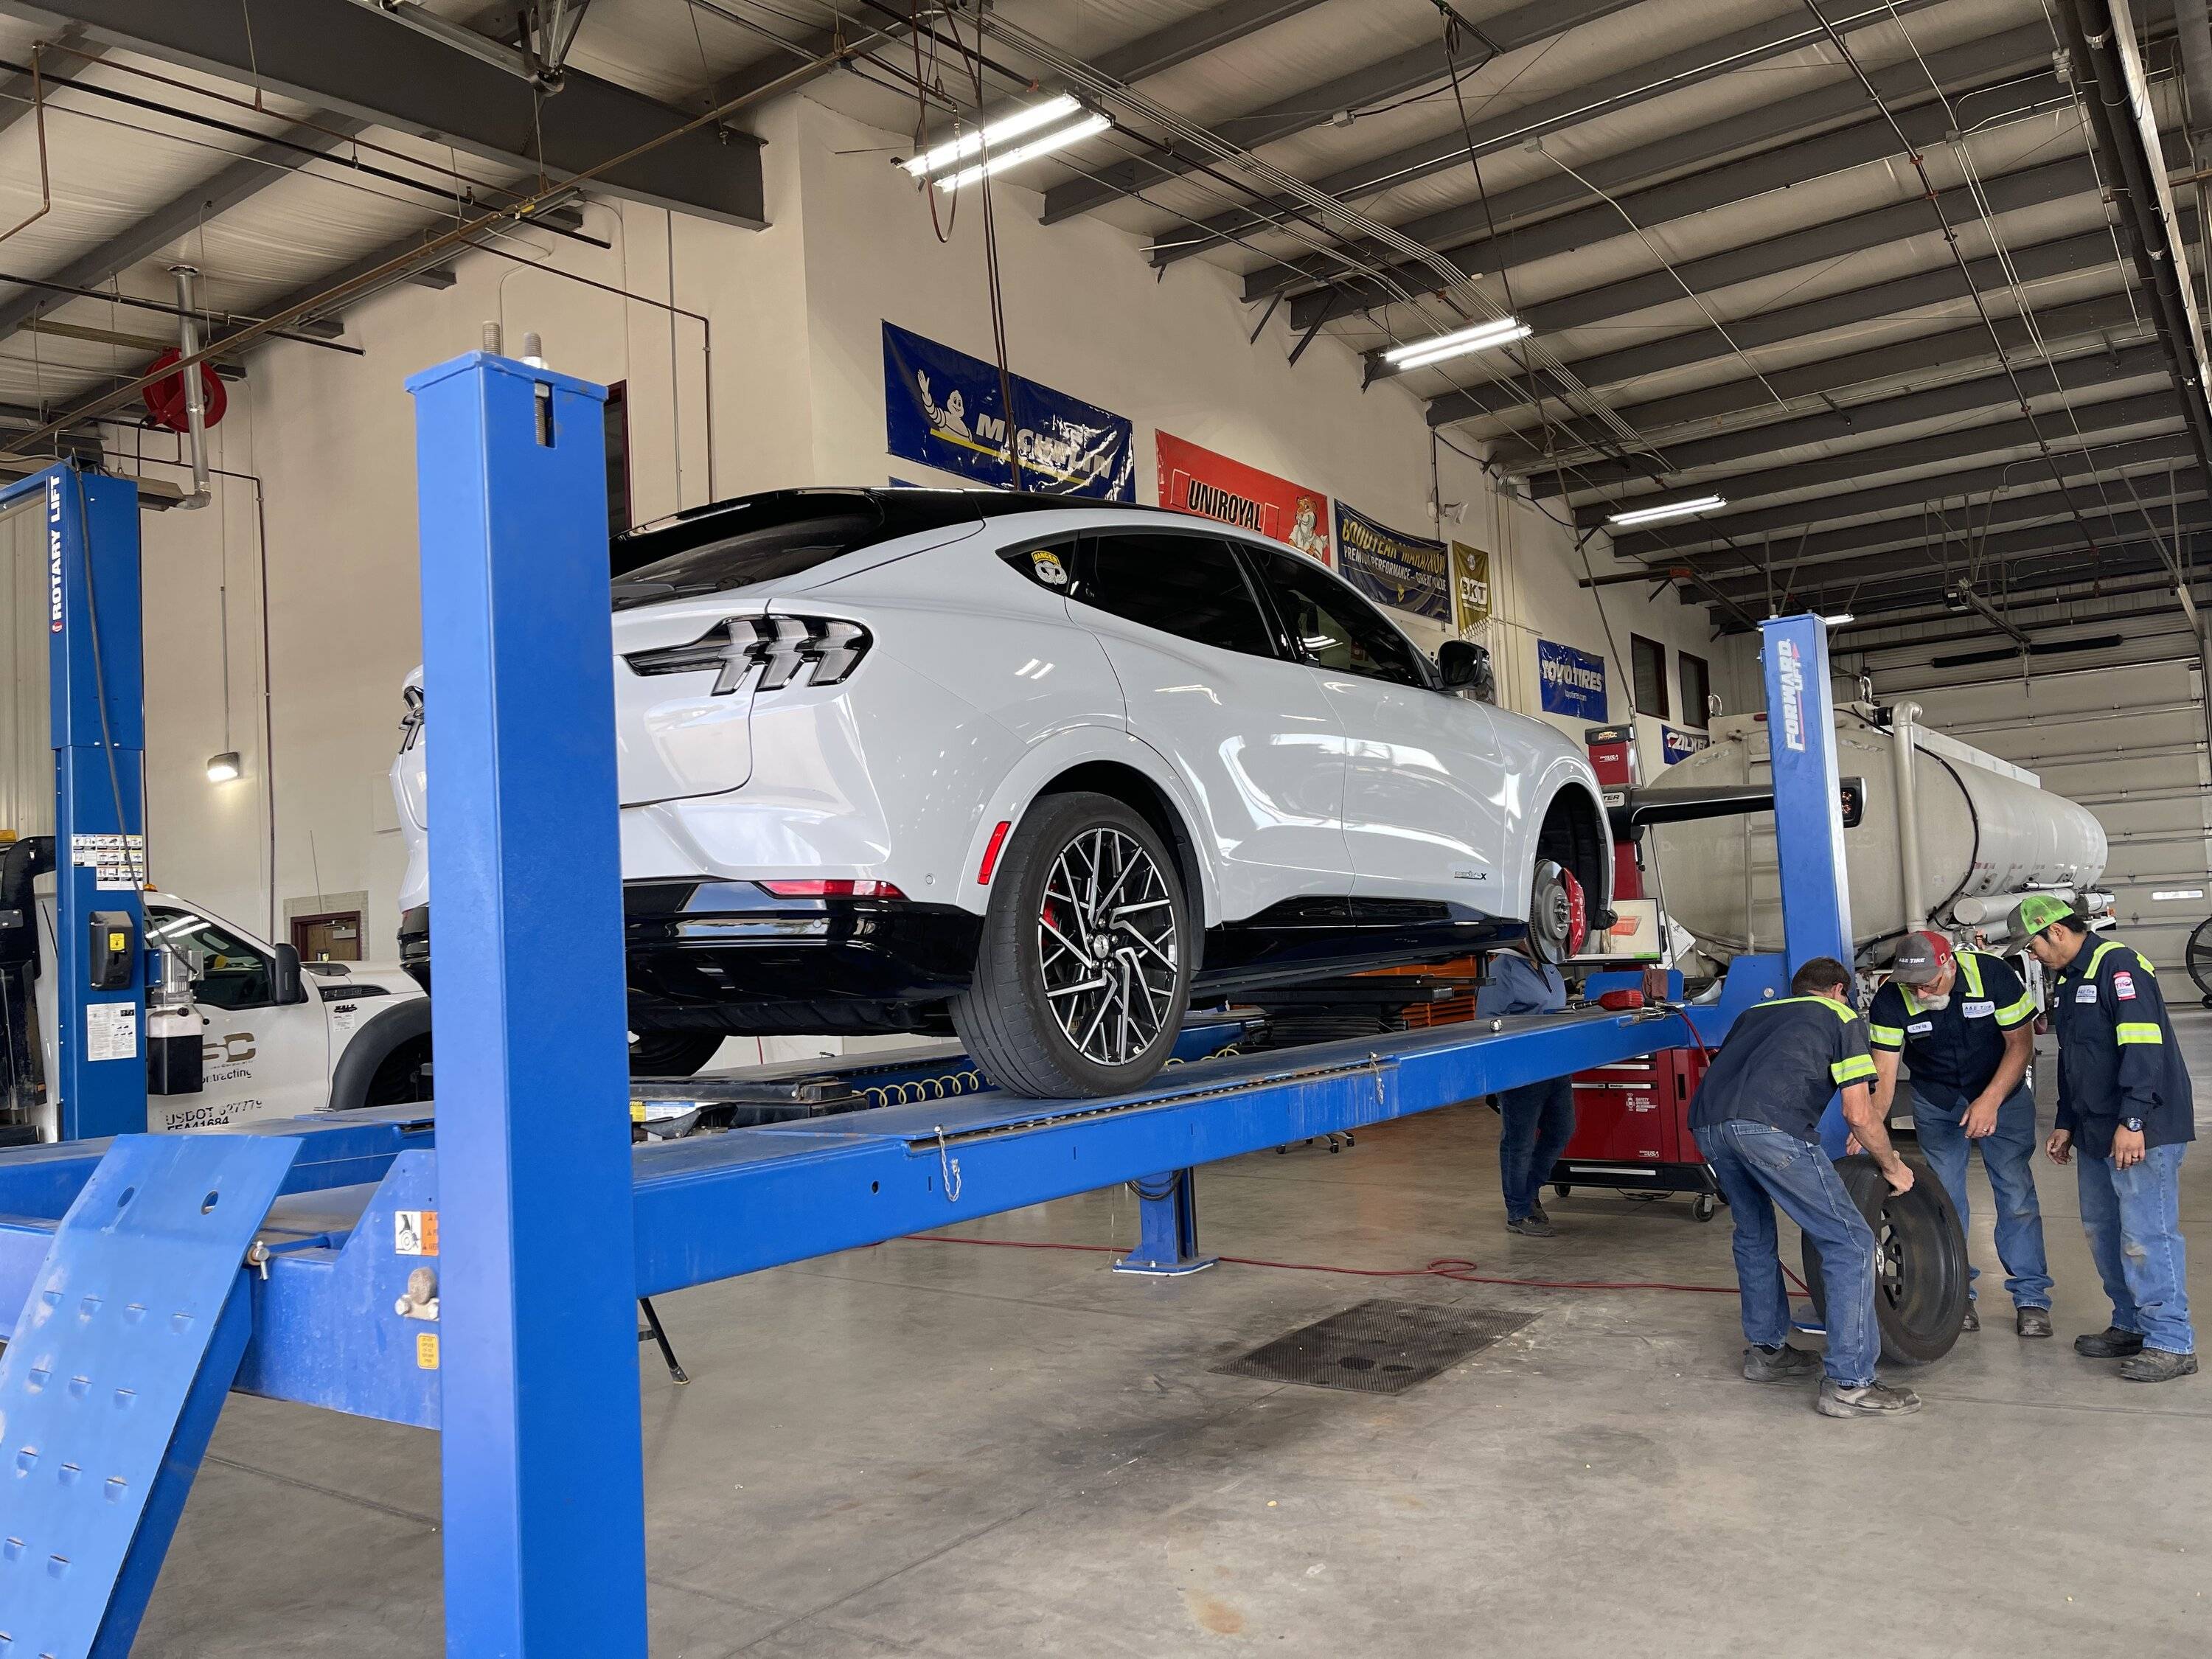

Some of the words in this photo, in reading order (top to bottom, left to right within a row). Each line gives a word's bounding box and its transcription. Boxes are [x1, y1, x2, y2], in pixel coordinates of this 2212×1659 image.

[976, 413, 1113, 479] MCHLIN
[50, 476, 60, 523] LIFT
[1188, 479, 1263, 532] UNIROYAL
[51, 529, 62, 620] ROTARY
[1034, 552, 1058, 563] RANGER
[1343, 545, 1369, 566] PREMI
[1371, 555, 1411, 581] PERFORMANCE
[1415, 572, 1432, 588] GREAT
[1461, 578, 1487, 603] BKT
[1573, 667, 1602, 692] TIRES
[1778, 639, 1805, 751] FORWARD
[1792, 658, 1803, 690] LIFT
[166, 1107, 214, 1125] USDOT
